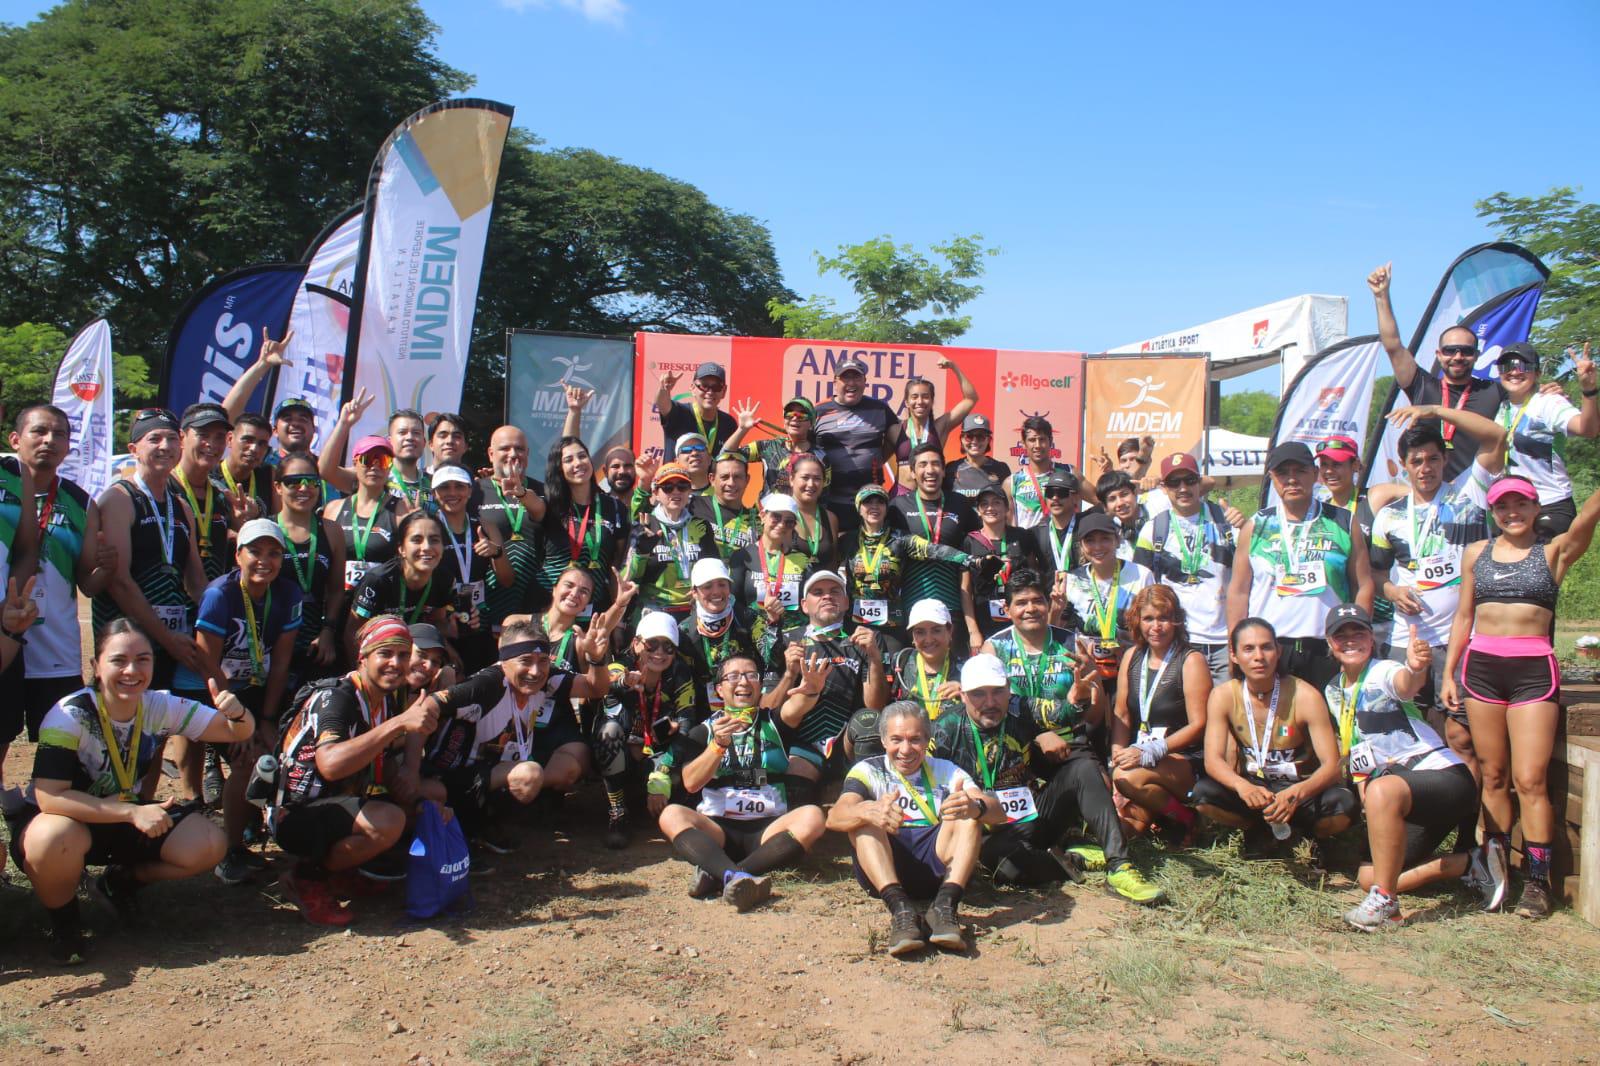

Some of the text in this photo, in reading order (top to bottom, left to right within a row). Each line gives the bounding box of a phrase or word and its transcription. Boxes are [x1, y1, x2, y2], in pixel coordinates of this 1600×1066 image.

[1106, 411, 1184, 433] IMDEM
[346, 570, 364, 583] 12
[1424, 562, 1455, 580] 095
[859, 607, 881, 618] 045
[735, 799, 766, 814] 140
